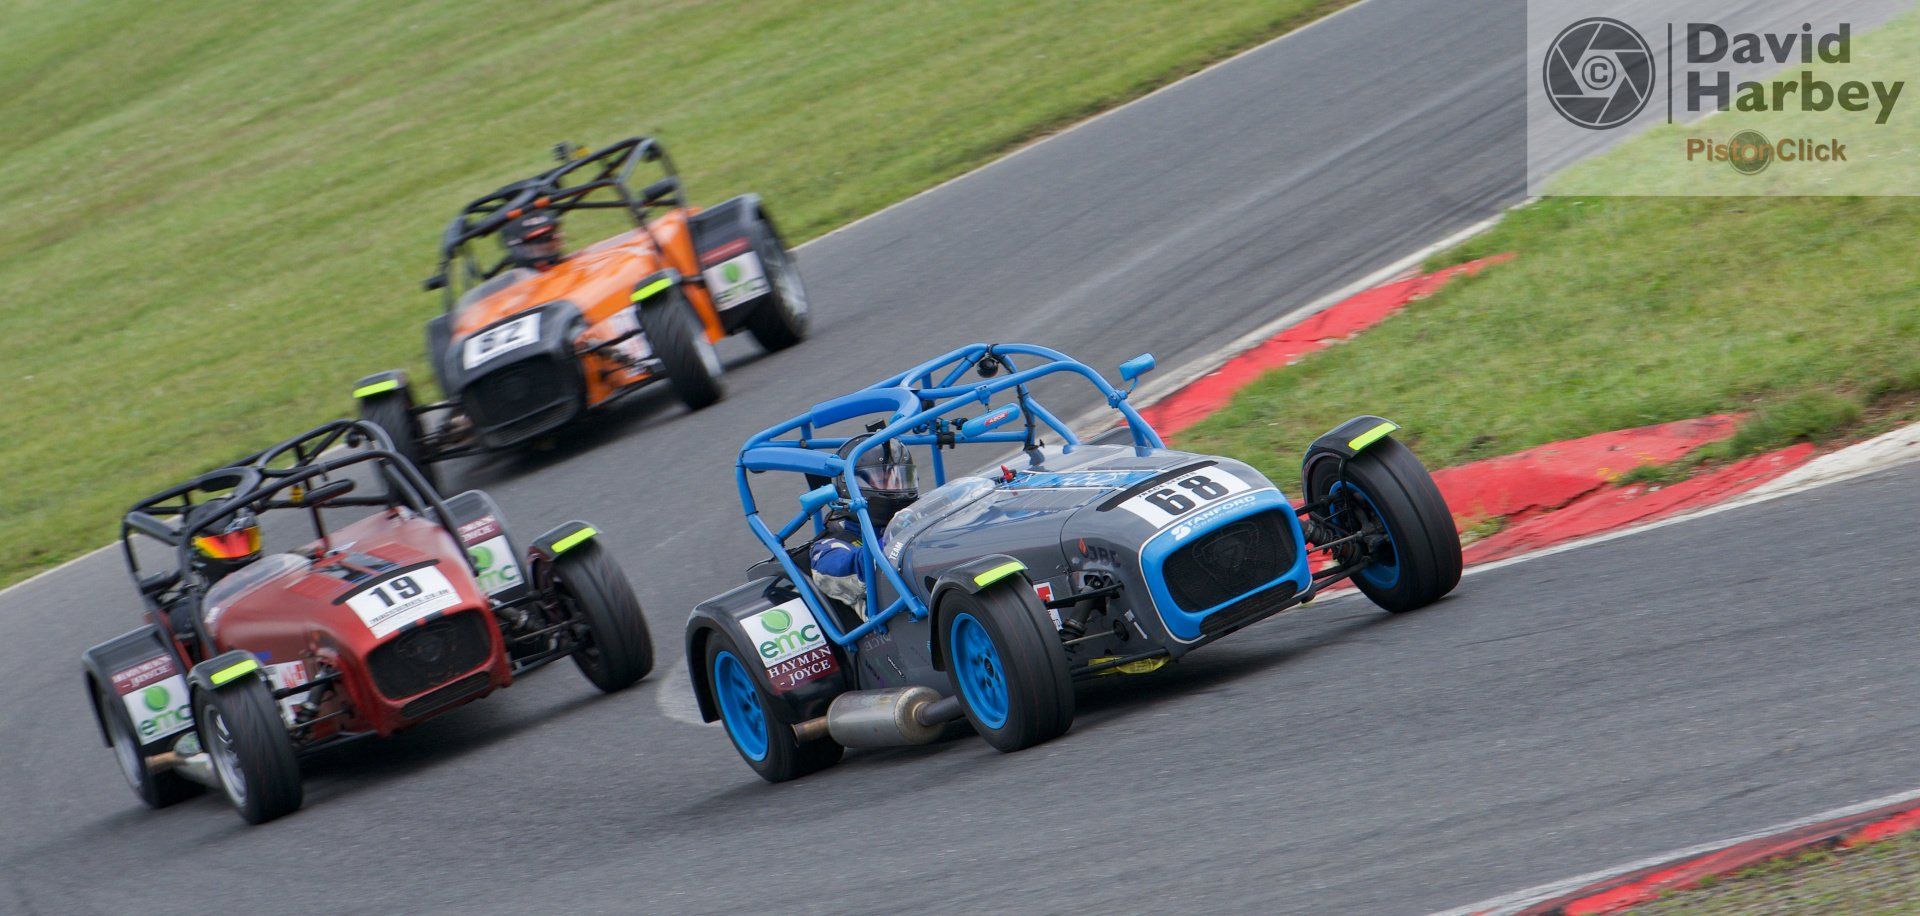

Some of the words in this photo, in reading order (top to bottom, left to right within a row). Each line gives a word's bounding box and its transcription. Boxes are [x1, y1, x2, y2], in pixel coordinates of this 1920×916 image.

[1144, 475, 1230, 516] 68
[1171, 495, 1257, 541] STANFORD
[368, 575, 424, 608] 19
[759, 624, 821, 659] emc
[767, 645, 832, 679] HAYMAN
[788, 659, 832, 686] JOYCE
[140, 703, 194, 736] emc
